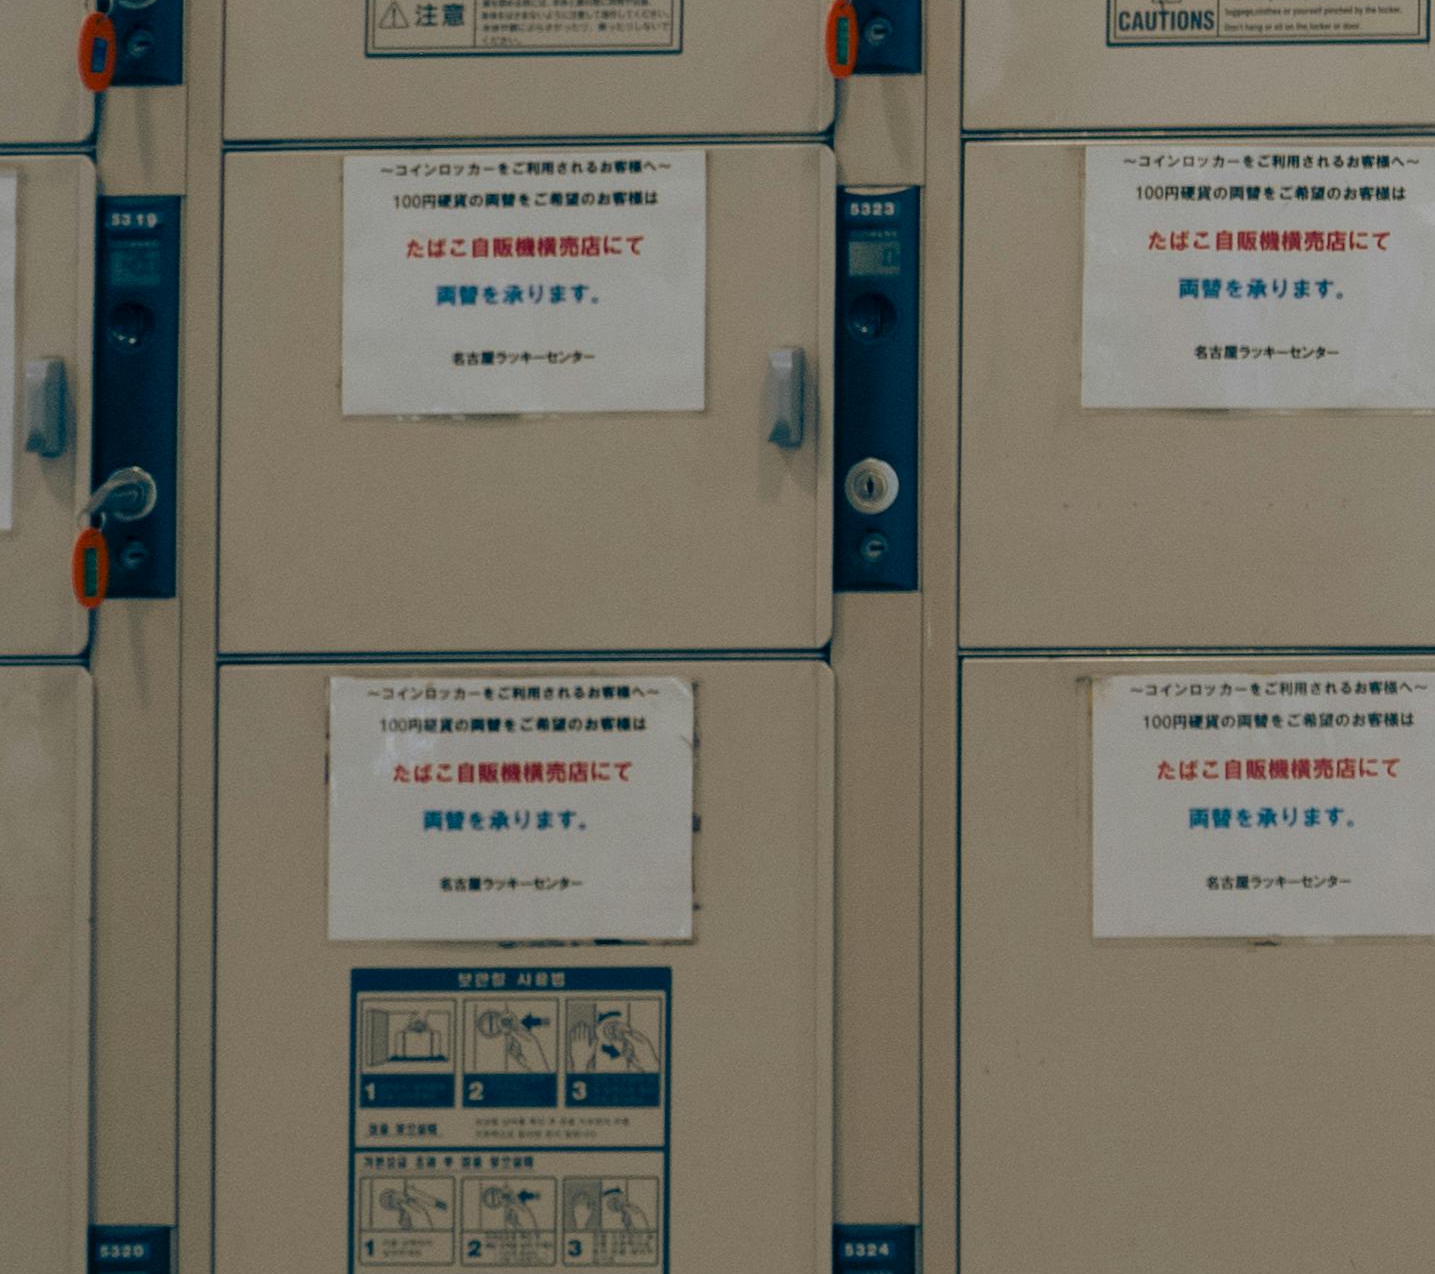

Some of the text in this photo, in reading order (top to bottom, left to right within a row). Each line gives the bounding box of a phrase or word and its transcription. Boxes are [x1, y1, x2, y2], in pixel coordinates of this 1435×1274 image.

[415, 3, 466, 28] 注意
[1118, 10, 1215, 32] CAUTIONS
[406, 234, 645, 259] たばこ自販機横売店にて
[1147, 229, 1391, 253] たばこ自販機横売店にて
[1178, 276, 1344, 300] 両替を承ります。
[393, 760, 633, 784] たばこ自販機横売店にて
[1188, 806, 1355, 830] 両替を承ります。
